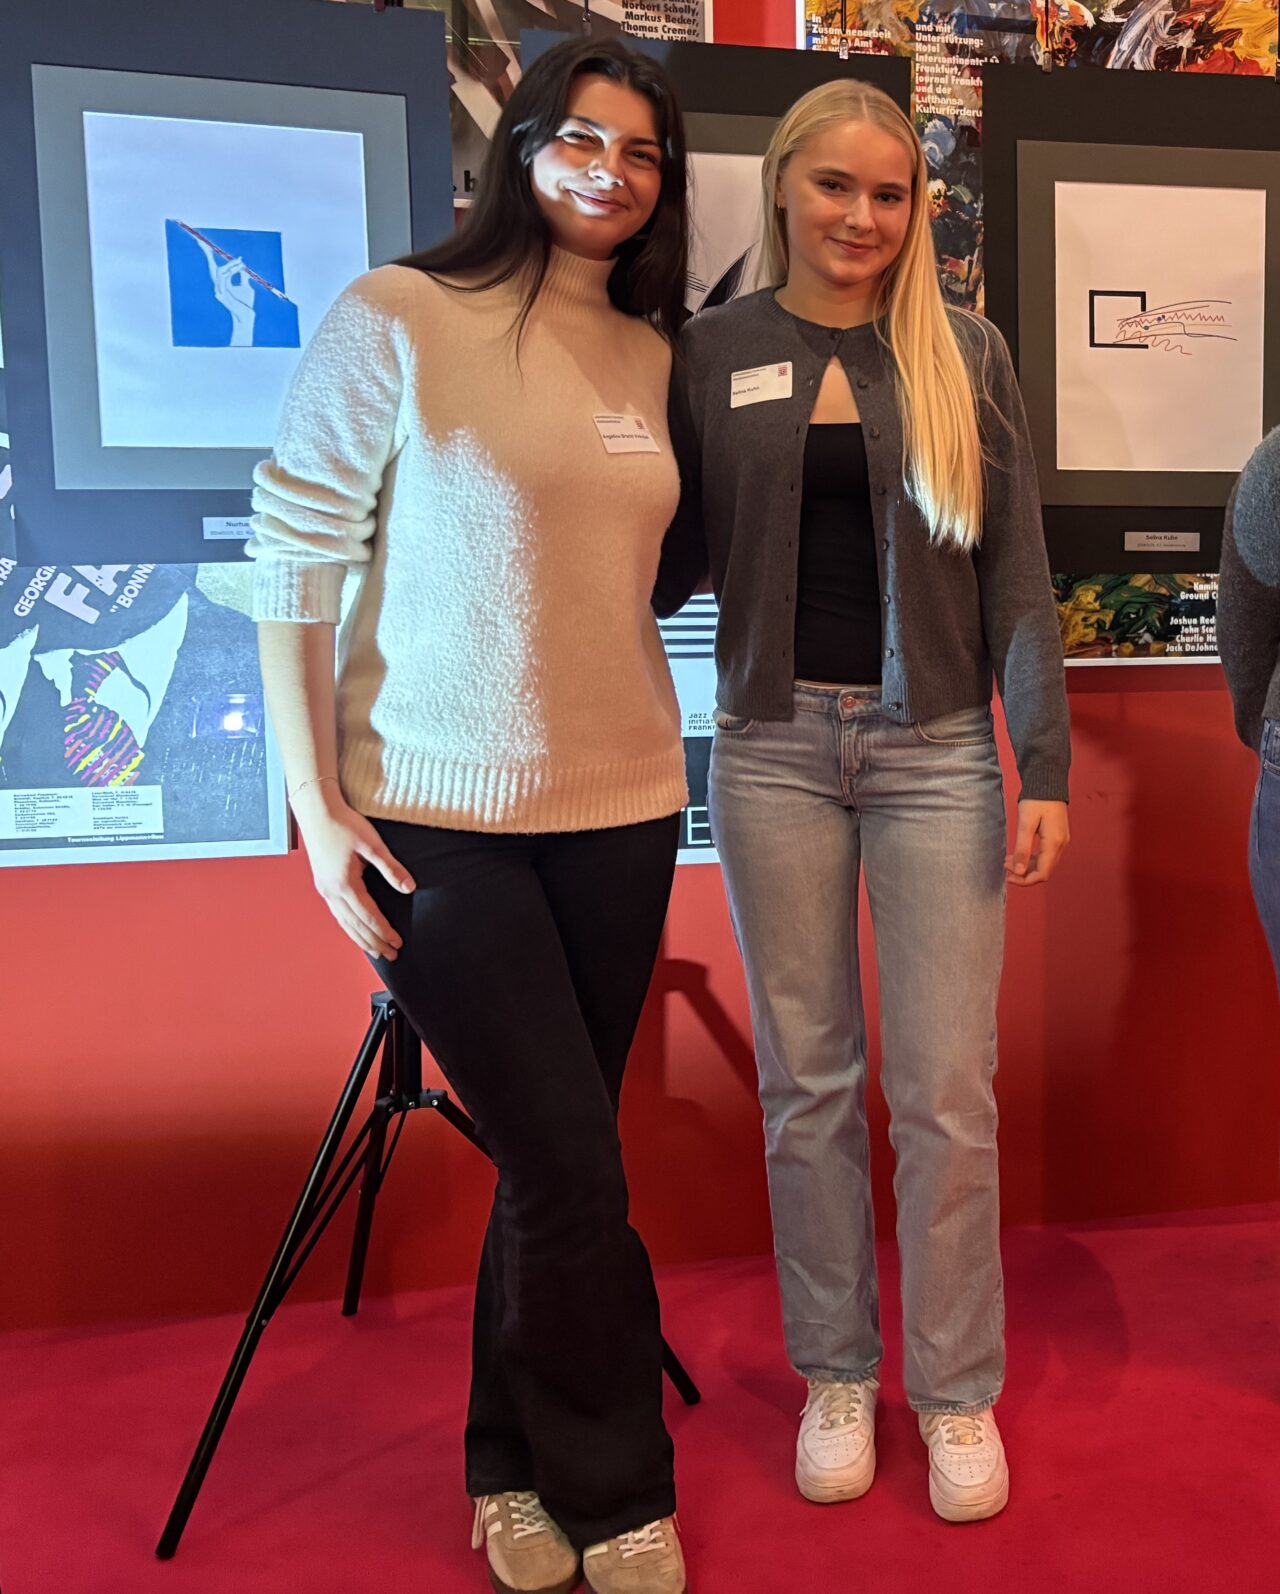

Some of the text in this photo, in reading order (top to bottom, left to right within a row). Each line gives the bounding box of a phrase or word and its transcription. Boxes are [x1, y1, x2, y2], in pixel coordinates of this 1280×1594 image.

[622, 0, 699, 16] Norbert Scholly,
[625, 11, 699, 27] Markus Becker,
[812, 13, 822, 23] In
[621, 21, 699, 37] Thomas Cremer,
[915, 22, 951, 33] und mit
[812, 36, 828, 45] mit
[854, 38, 873, 48] Amt
[915, 32, 984, 48] Unterstützung:
[915, 42, 940, 53] Hotel
[915, 62, 961, 76] Frankfurt,
[915, 72, 948, 84] journal
[915, 84, 952, 94] und der
[915, 94, 964, 106] Lufthansa
[1180, 591, 1209, 601] Ground
[1169, 616, 1216, 627] Joshua Red
[1180, 625, 1200, 634] John
[1175, 634, 1204, 643] Charlie
[1165, 643, 1183, 653] Jack
